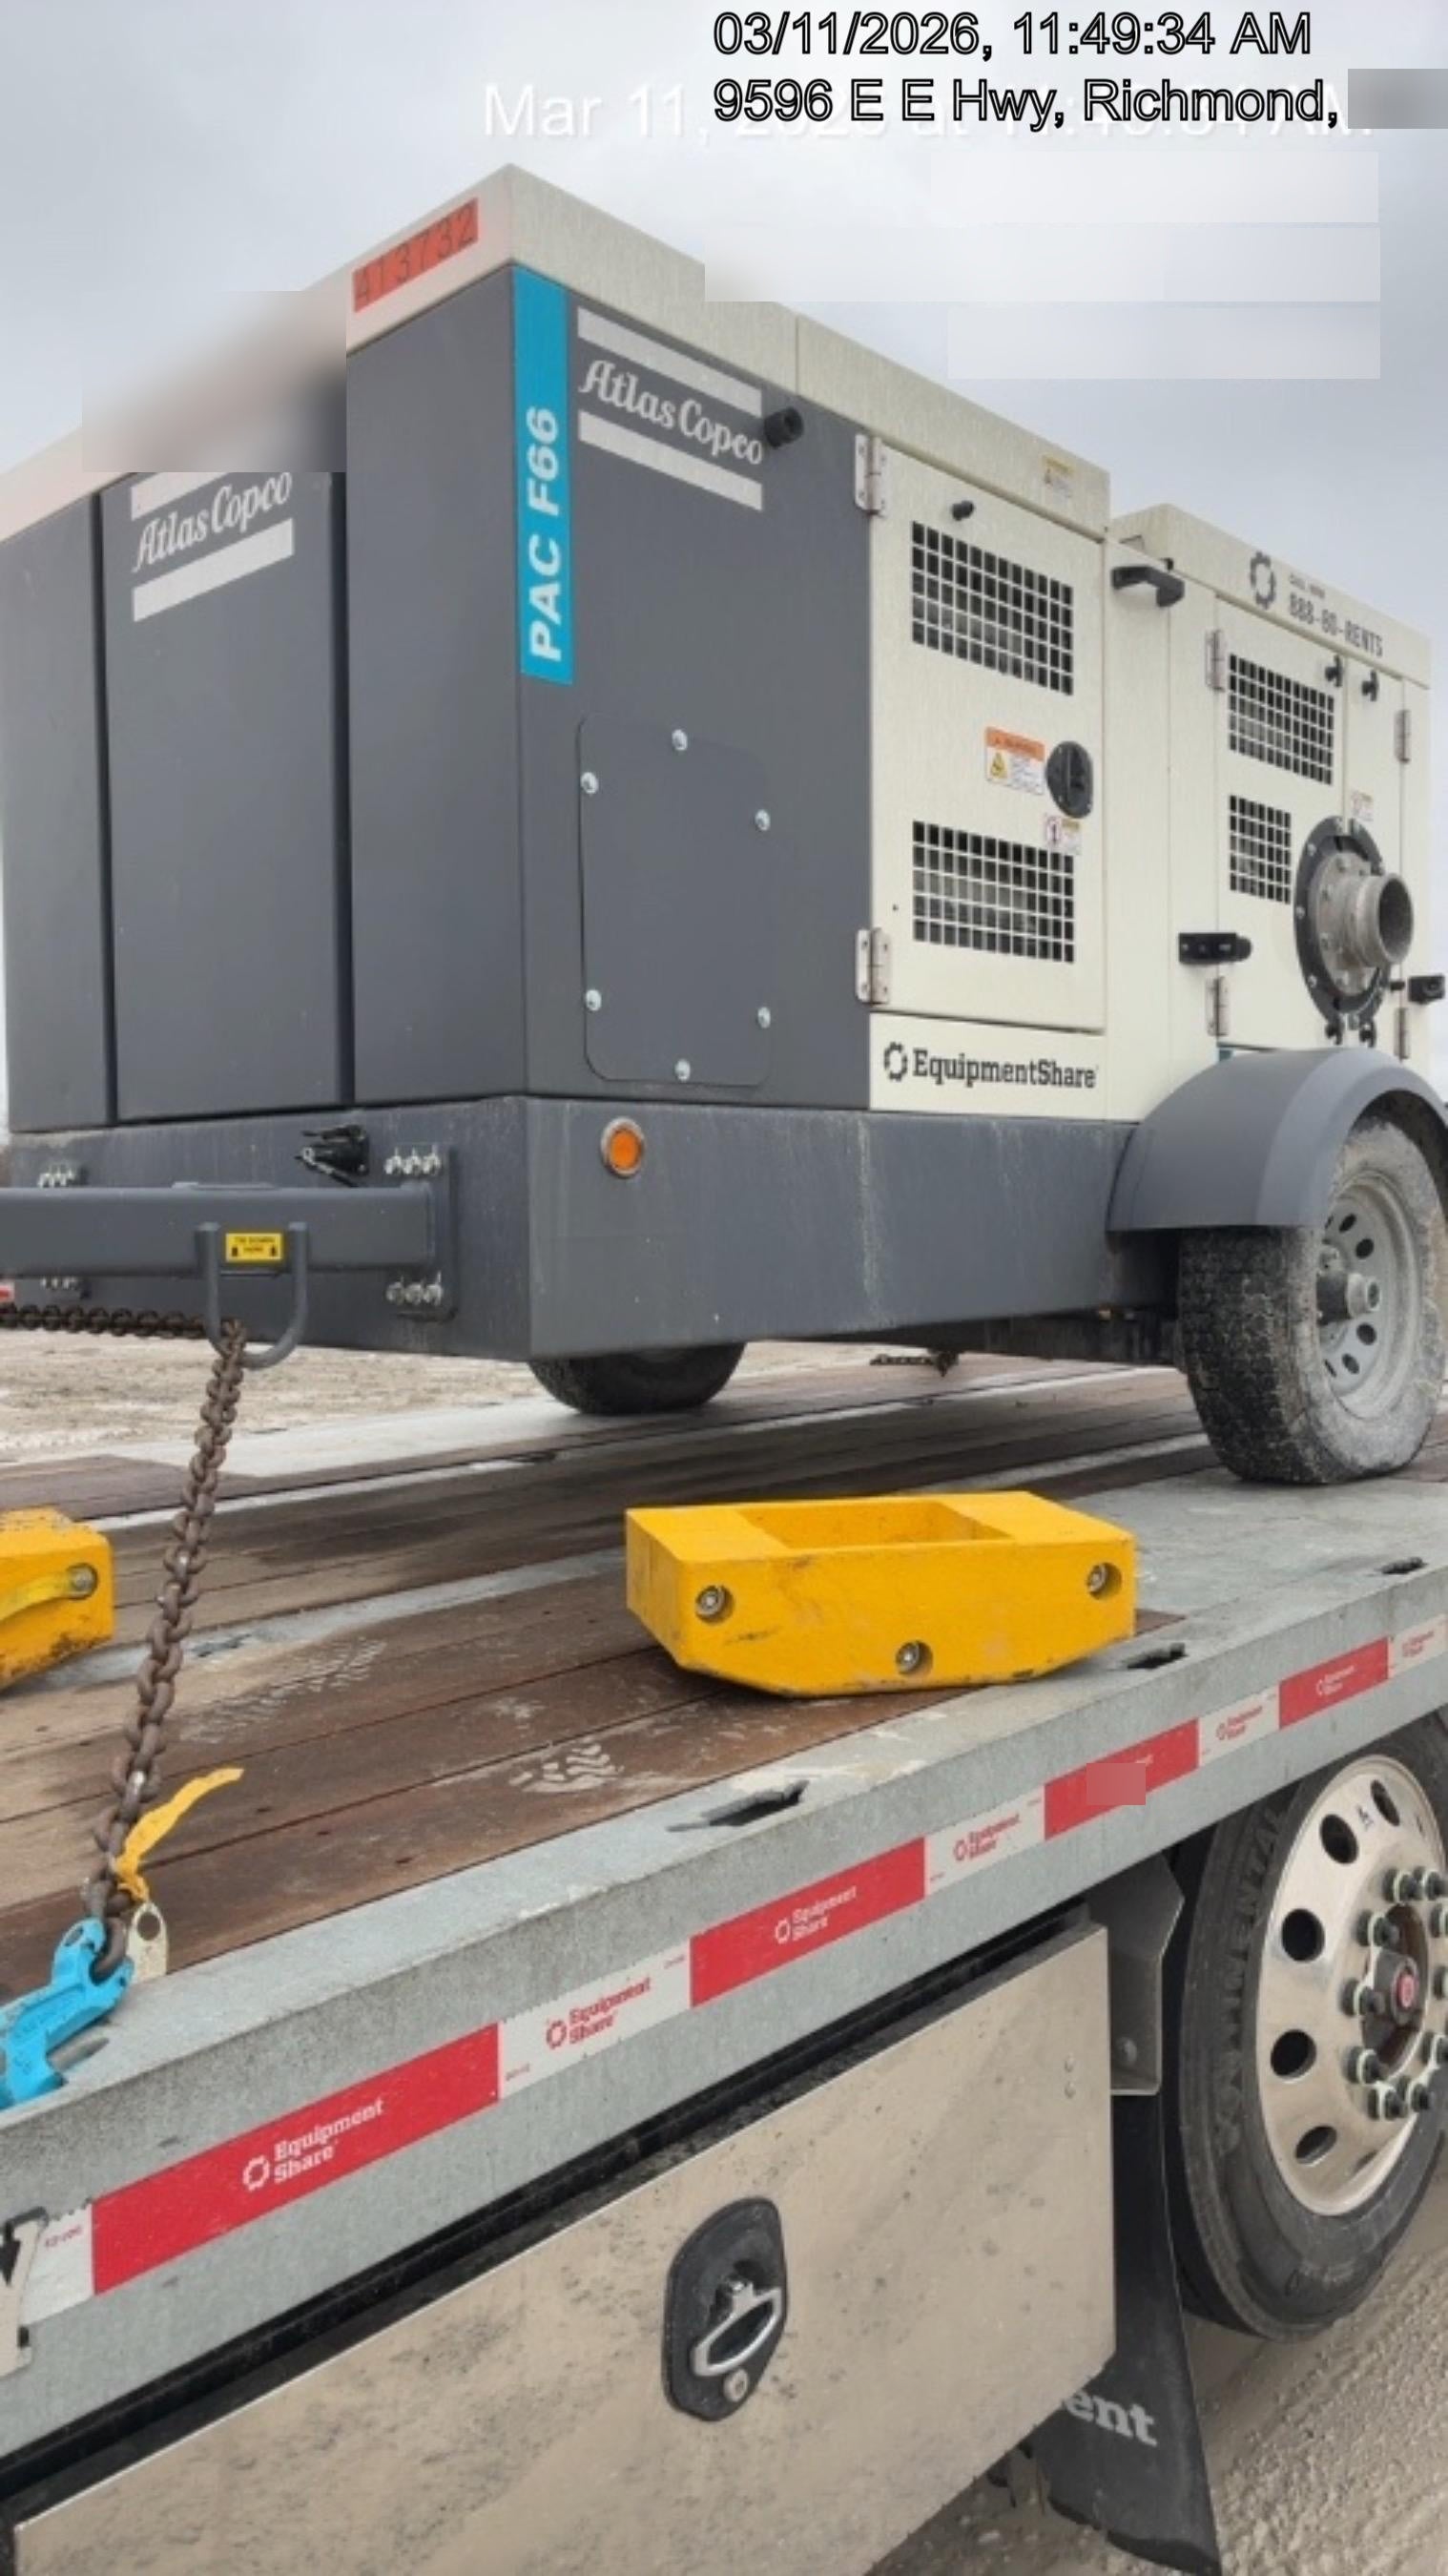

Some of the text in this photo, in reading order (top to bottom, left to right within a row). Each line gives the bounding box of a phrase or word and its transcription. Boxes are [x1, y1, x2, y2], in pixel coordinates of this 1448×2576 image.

[578, 360, 763, 465] Atlas Copco
[131, 471, 293, 572] Atlas Copco
[527, 405, 562, 662] PAC F66
[912, 1048, 1097, 1089] EquipmentShare
[274, 2097, 384, 2162] Equipment
[274, 2145, 334, 2185] Share
[1061, 2389, 1157, 2447] ent
